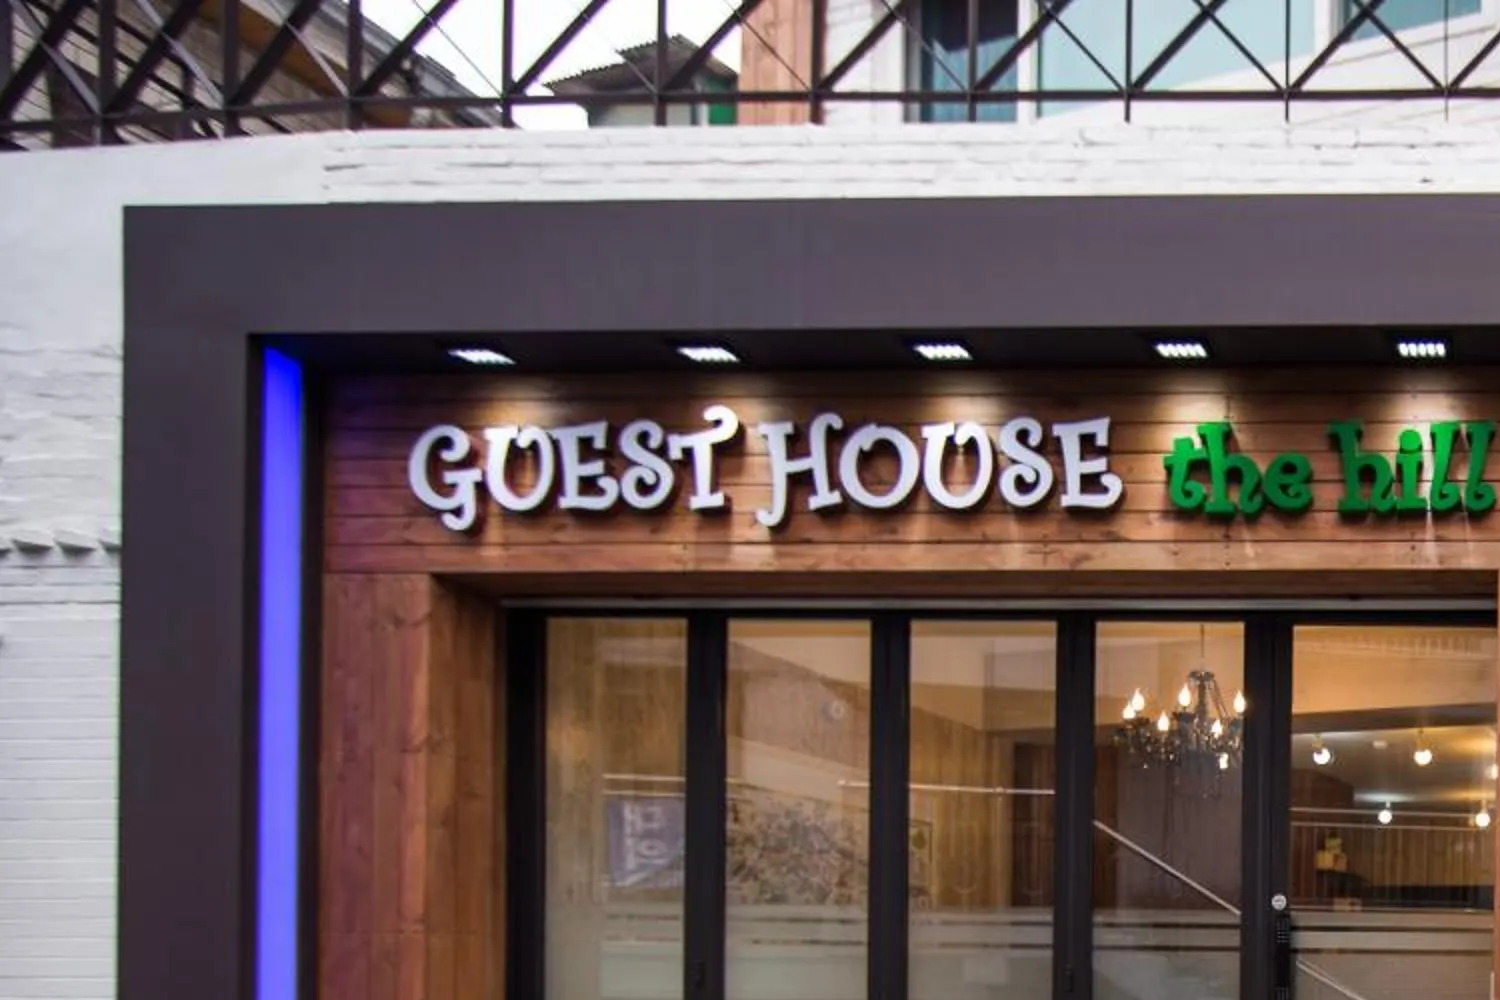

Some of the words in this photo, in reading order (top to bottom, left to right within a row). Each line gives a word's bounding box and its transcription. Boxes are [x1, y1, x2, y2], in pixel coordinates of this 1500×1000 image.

[407, 404, 741, 531] GUEST
[755, 411, 1125, 528] HOUSE
[1163, 421, 1314, 516] the
[1328, 419, 1498, 515] hill
